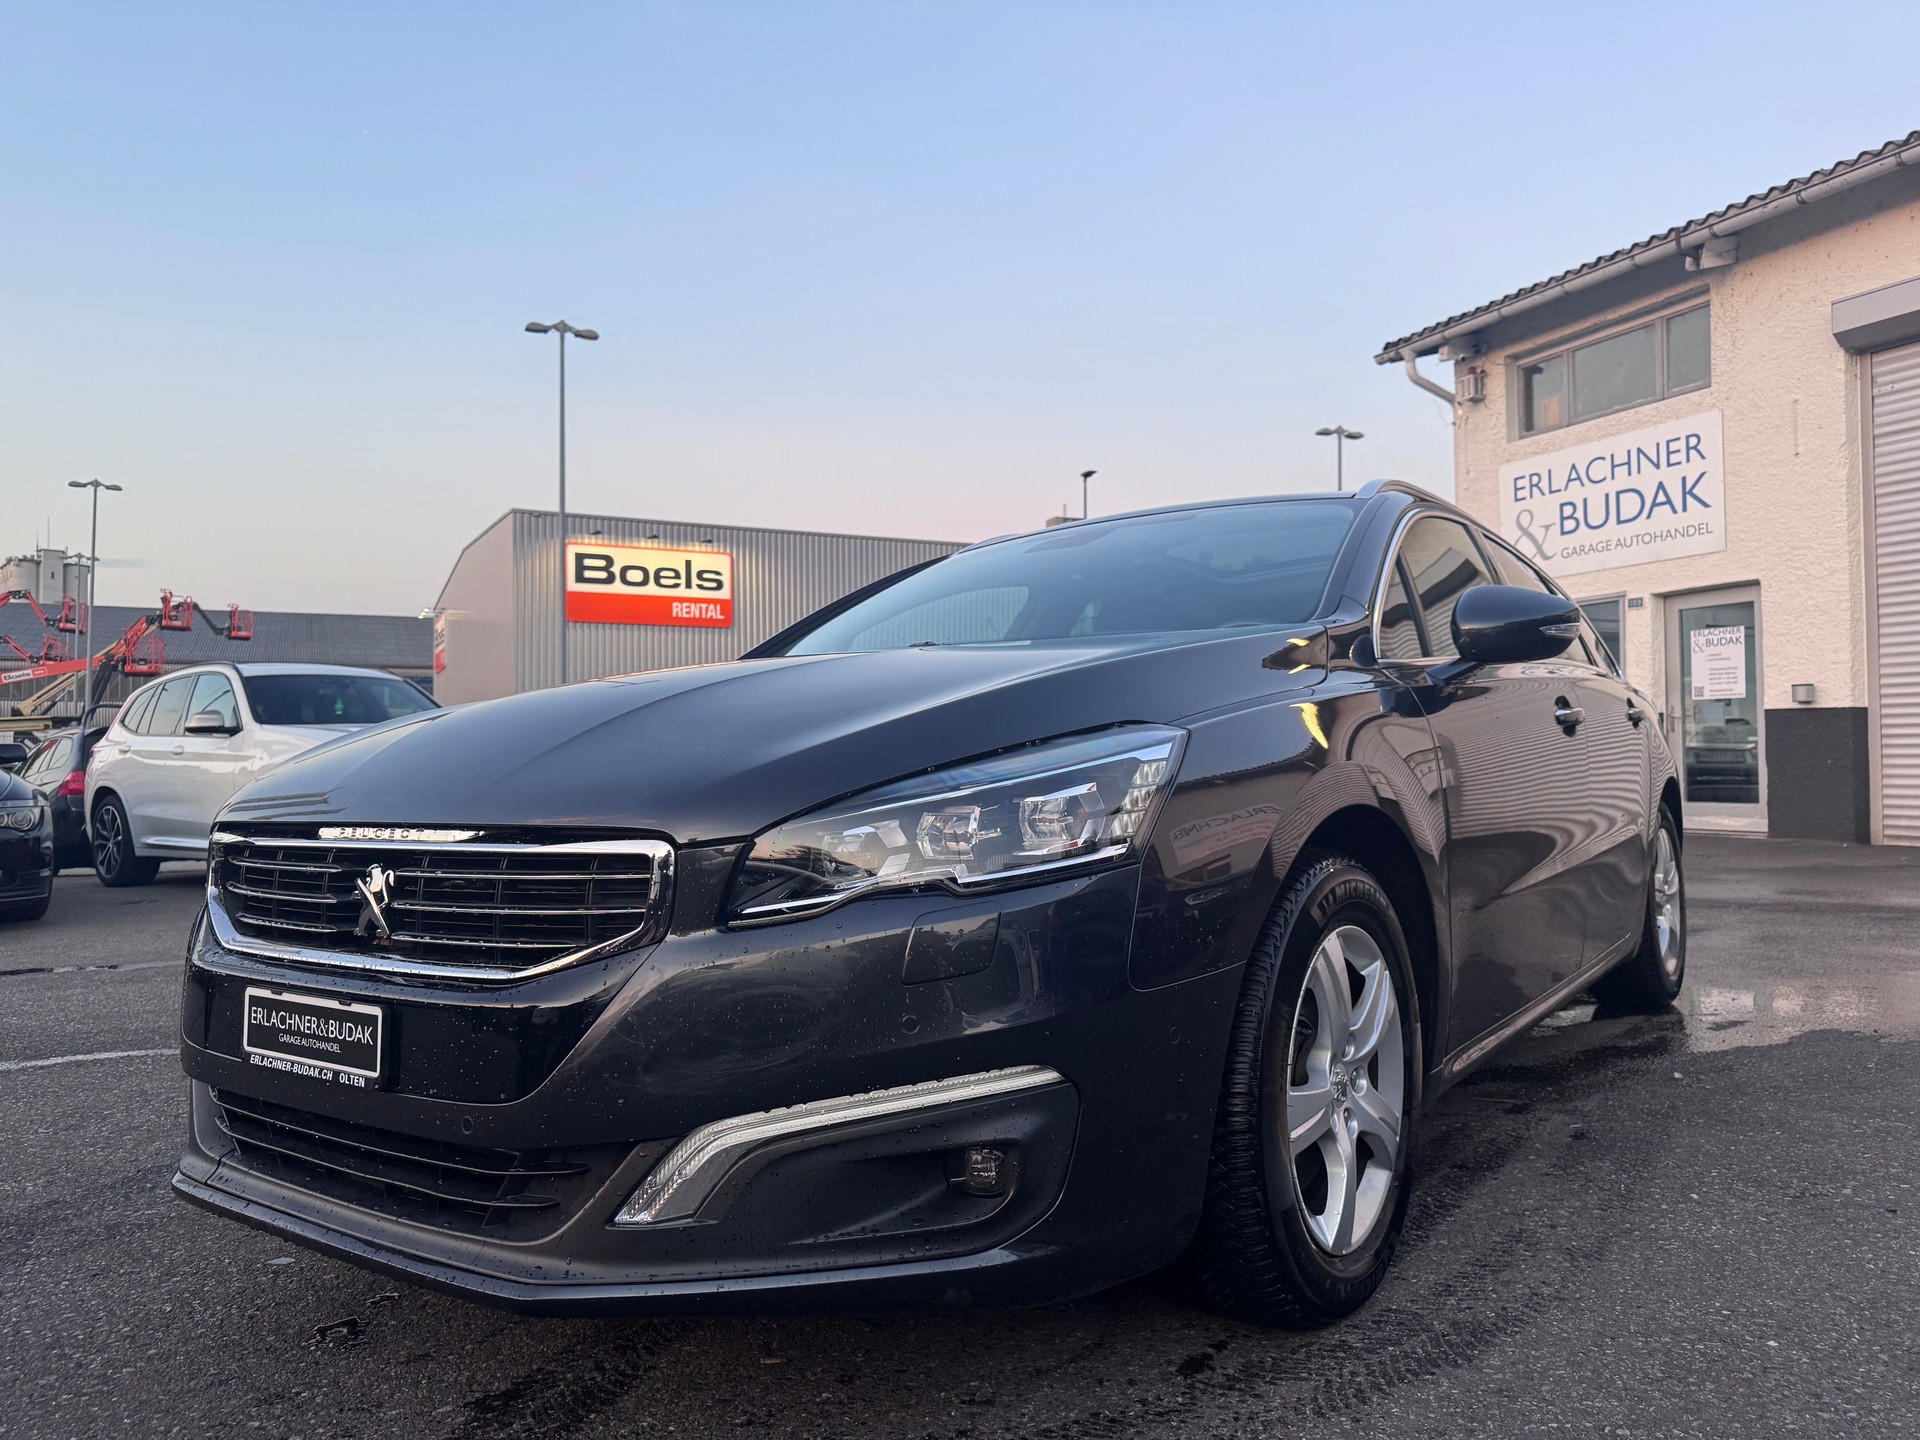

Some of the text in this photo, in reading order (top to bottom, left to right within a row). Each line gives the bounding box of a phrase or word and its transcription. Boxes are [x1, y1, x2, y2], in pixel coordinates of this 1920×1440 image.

[1513, 433, 1706, 502] ERLACHNER
[1513, 471, 1712, 561] & BUDAK
[1561, 522, 1713, 559] GARAGE AUTOHANDEL
[574, 552, 724, 591] Boels
[672, 602, 725, 619] RENTAL
[1693, 626, 1742, 638] ERLACHNER
[1705, 635, 1742, 647] BUDAK
[251, 1006, 373, 1045] ERLACHNER&BUDAK
[278, 1033, 341, 1053] GARAGE AUTOHANDEL
[250, 1054, 365, 1088] ERLACHNER-BUDAK.CH OLTEN
